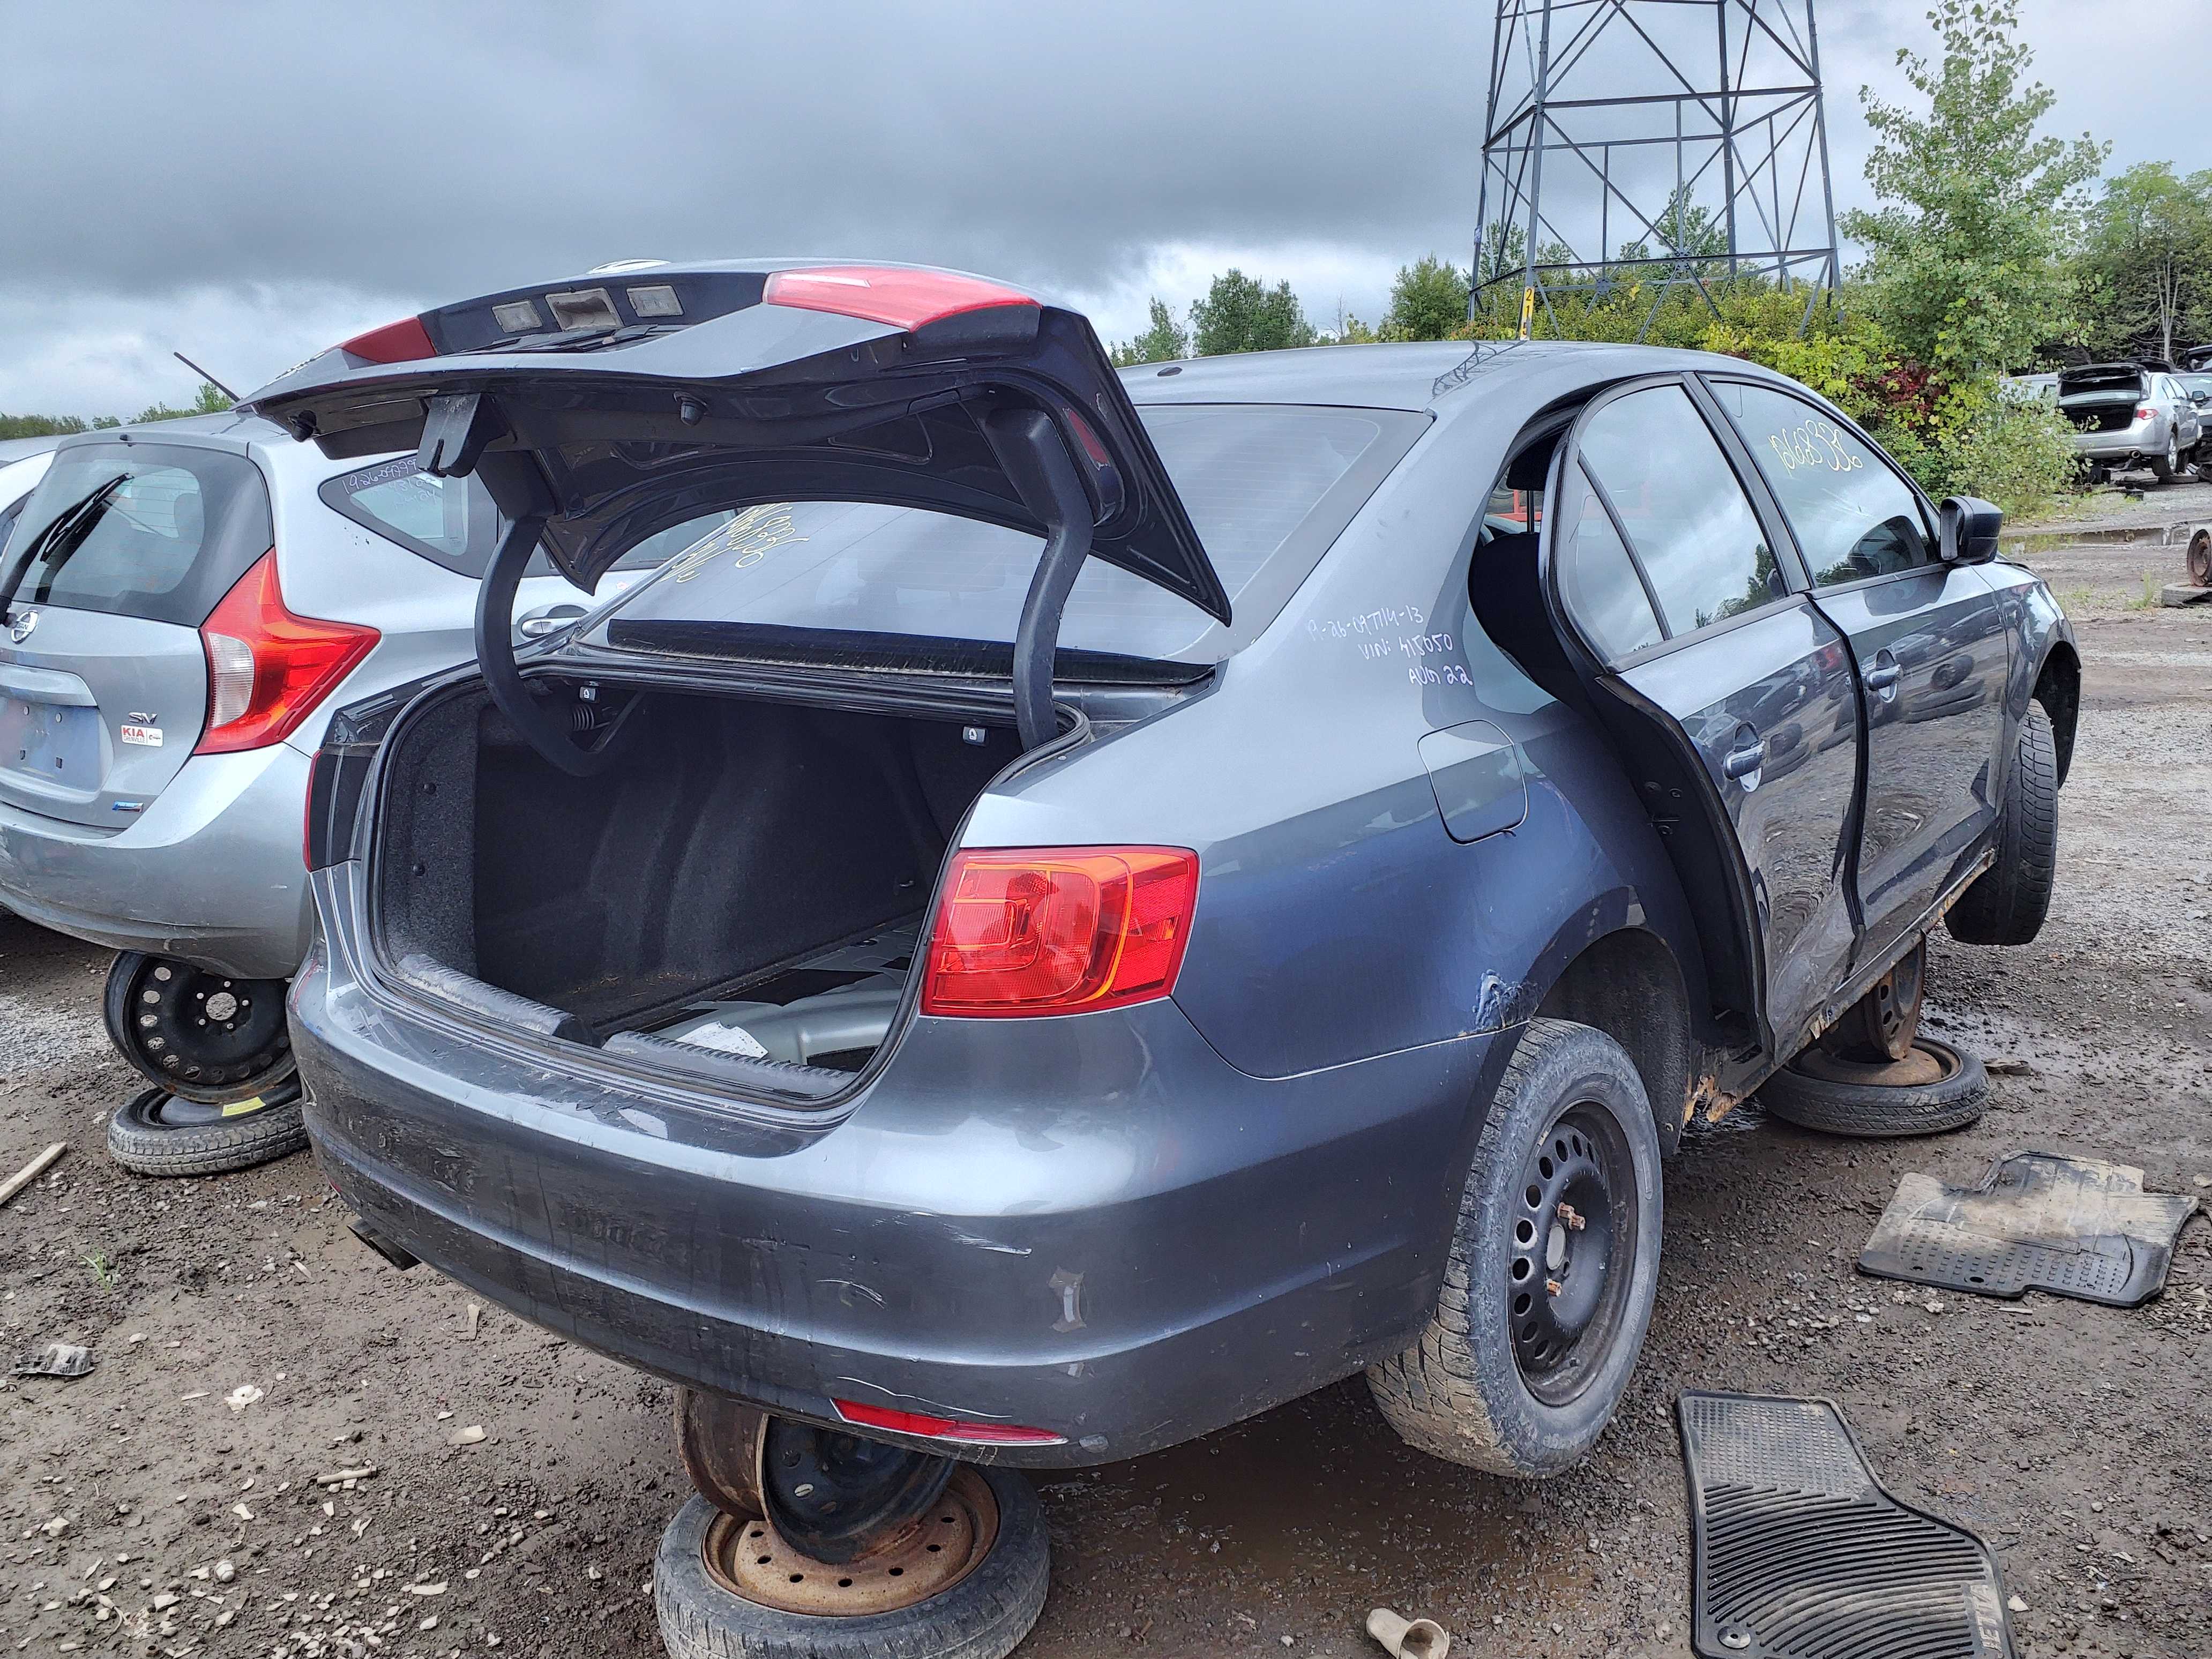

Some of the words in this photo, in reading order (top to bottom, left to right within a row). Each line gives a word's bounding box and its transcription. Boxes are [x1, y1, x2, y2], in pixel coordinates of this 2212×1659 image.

[1358, 638, 1392, 660] VIN:
[1399, 633, 1454, 658] 415050
[1443, 664, 1473, 686] 22
[128, 712, 159, 724] SV
[123, 727, 145, 738] KIA
